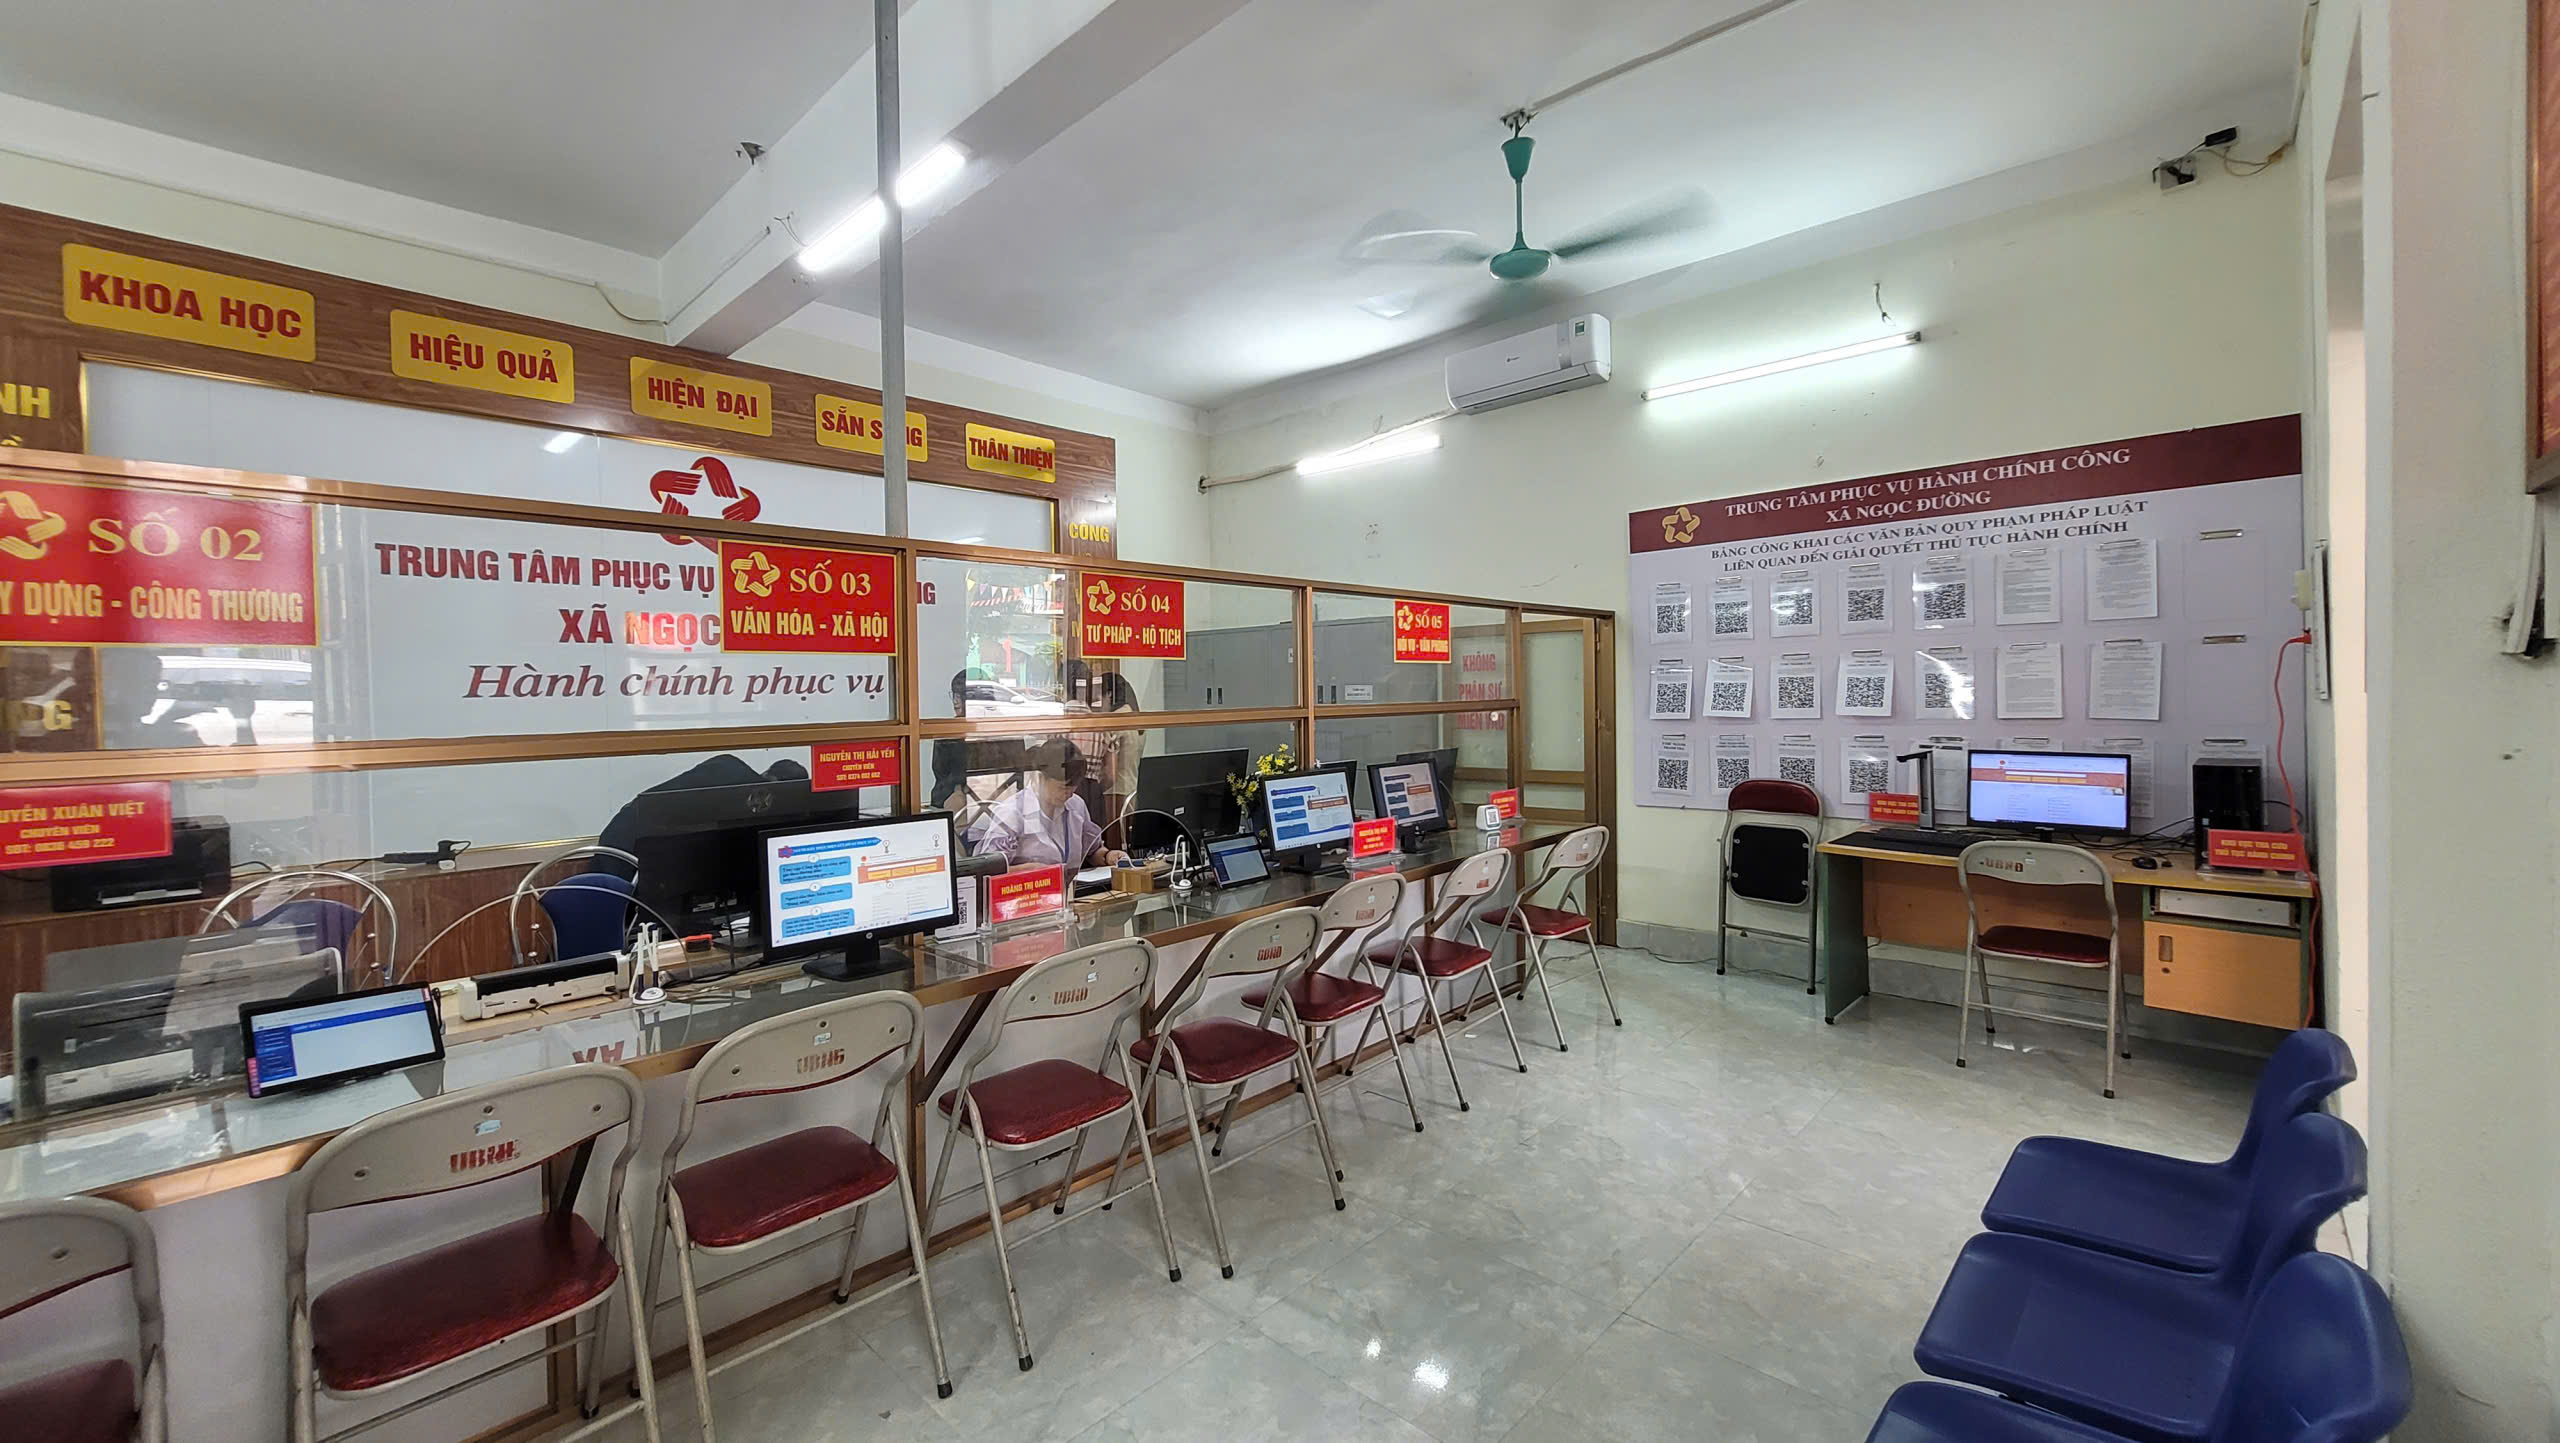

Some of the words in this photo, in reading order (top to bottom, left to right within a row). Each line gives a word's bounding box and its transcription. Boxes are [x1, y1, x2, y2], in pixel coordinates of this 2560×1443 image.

[80, 270, 203, 322] KHOA
[220, 296, 301, 340] HỌC
[410, 332, 484, 372] HIỆU
[496, 349, 558, 384] QUẢ
[648, 376, 705, 411] HIỆN
[716, 391, 758, 421] ĐẠI
[821, 406, 864, 437] SẴN
[870, 420, 922, 447] SG
[968, 436, 1010, 463] THÂN
[1011, 442, 1054, 472] THIỆN
[1725, 498, 1782, 517] TRUNG
[1786, 491, 1825, 508] TÂM
[1830, 484, 1881, 504] PHỤC
[1885, 479, 1913, 495] VỤ
[1918, 472, 1977, 490] HÀNH
[1983, 459, 2055, 481] CHÍNH
[2061, 448, 2131, 470] CÔNG
[1825, 506, 1851, 523] XÃ
[1856, 500, 1912, 519] NGỌC
[1917, 490, 1992, 511] ĐƯỜNG
[88, 506, 181, 557] SỐ
[200, 525, 263, 561] 02
[1069, 519, 1110, 543] CÔNG
[1711, 544, 1747, 559] BẢNG
[1750, 540, 1789, 555] CÔNG
[1793, 535, 1830, 550] KHAI
[1833, 530, 1866, 545] CÁC
[1868, 527, 1900, 540] VĂN
[1904, 523, 1937, 537] BẢN
[1941, 519, 1977, 534] QUY
[1982, 513, 2034, 530] PHẠM
[2040, 506, 2090, 523] PHÁP
[2095, 500, 2148, 517] LUẬT
[1723, 559, 1756, 572] LIÊN
[1757, 556, 1797, 569] QUAN
[1800, 549, 1829, 564] ĐẾN
[1832, 550, 1865, 561] GIẢI
[1869, 539, 1924, 557] QUYẾT
[1927, 536, 1962, 551] THỦ
[1967, 534, 2002, 549] TỤC
[2007, 528, 2059, 544] HÀNH
[2065, 521, 2128, 537] CHÍNH
[374, 543, 499, 581] TRUNG
[508, 548, 581, 586] TÂM
[592, 558, 672, 596] PHỤC
[679, 564, 714, 597] VỤ
[790, 560, 833, 597] SỐ
[840, 571, 872, 597] 03
[24, 580, 103, 624] DỰNG
[111, 599, 122, 609] -
[130, 580, 201, 620] CÔNG
[207, 588, 304, 623] THƯƠNG
[1121, 585, 1147, 613] SỐ
[1150, 593, 1171, 613] 04
[559, 604, 613, 645] XÃ
[624, 610, 720, 653] NGỌC
[730, 608, 770, 636] VĂN
[776, 610, 814, 636] HÓA
[832, 610, 857, 638] XÃ
[859, 611, 889, 642] HỘI
[1087, 623, 1102, 645] TƯ
[1104, 621, 1132, 645] PHÁP
[1142, 624, 1157, 648] HỘ
[1159, 624, 1181, 649] TỊCH
[1415, 608, 1430, 629] SỐ
[1431, 615, 1443, 629] 05
[1462, 651, 1496, 672] KHÔNG
[462, 664, 605, 699] Hành
[619, 663, 733, 697] chính
[744, 665, 835, 702] phục
[846, 674, 884, 701] vụ
[820, 750, 851, 762] NGUYỄN
[853, 750, 865, 761] THỊ
[53, 803, 104, 820] XUÂN
[108, 800, 144, 818] VIỆT
[1002, 882, 1023, 895] HOÀNG
[1024, 881, 1034, 891] THỊ
[1035, 878, 1051, 889] OANH
